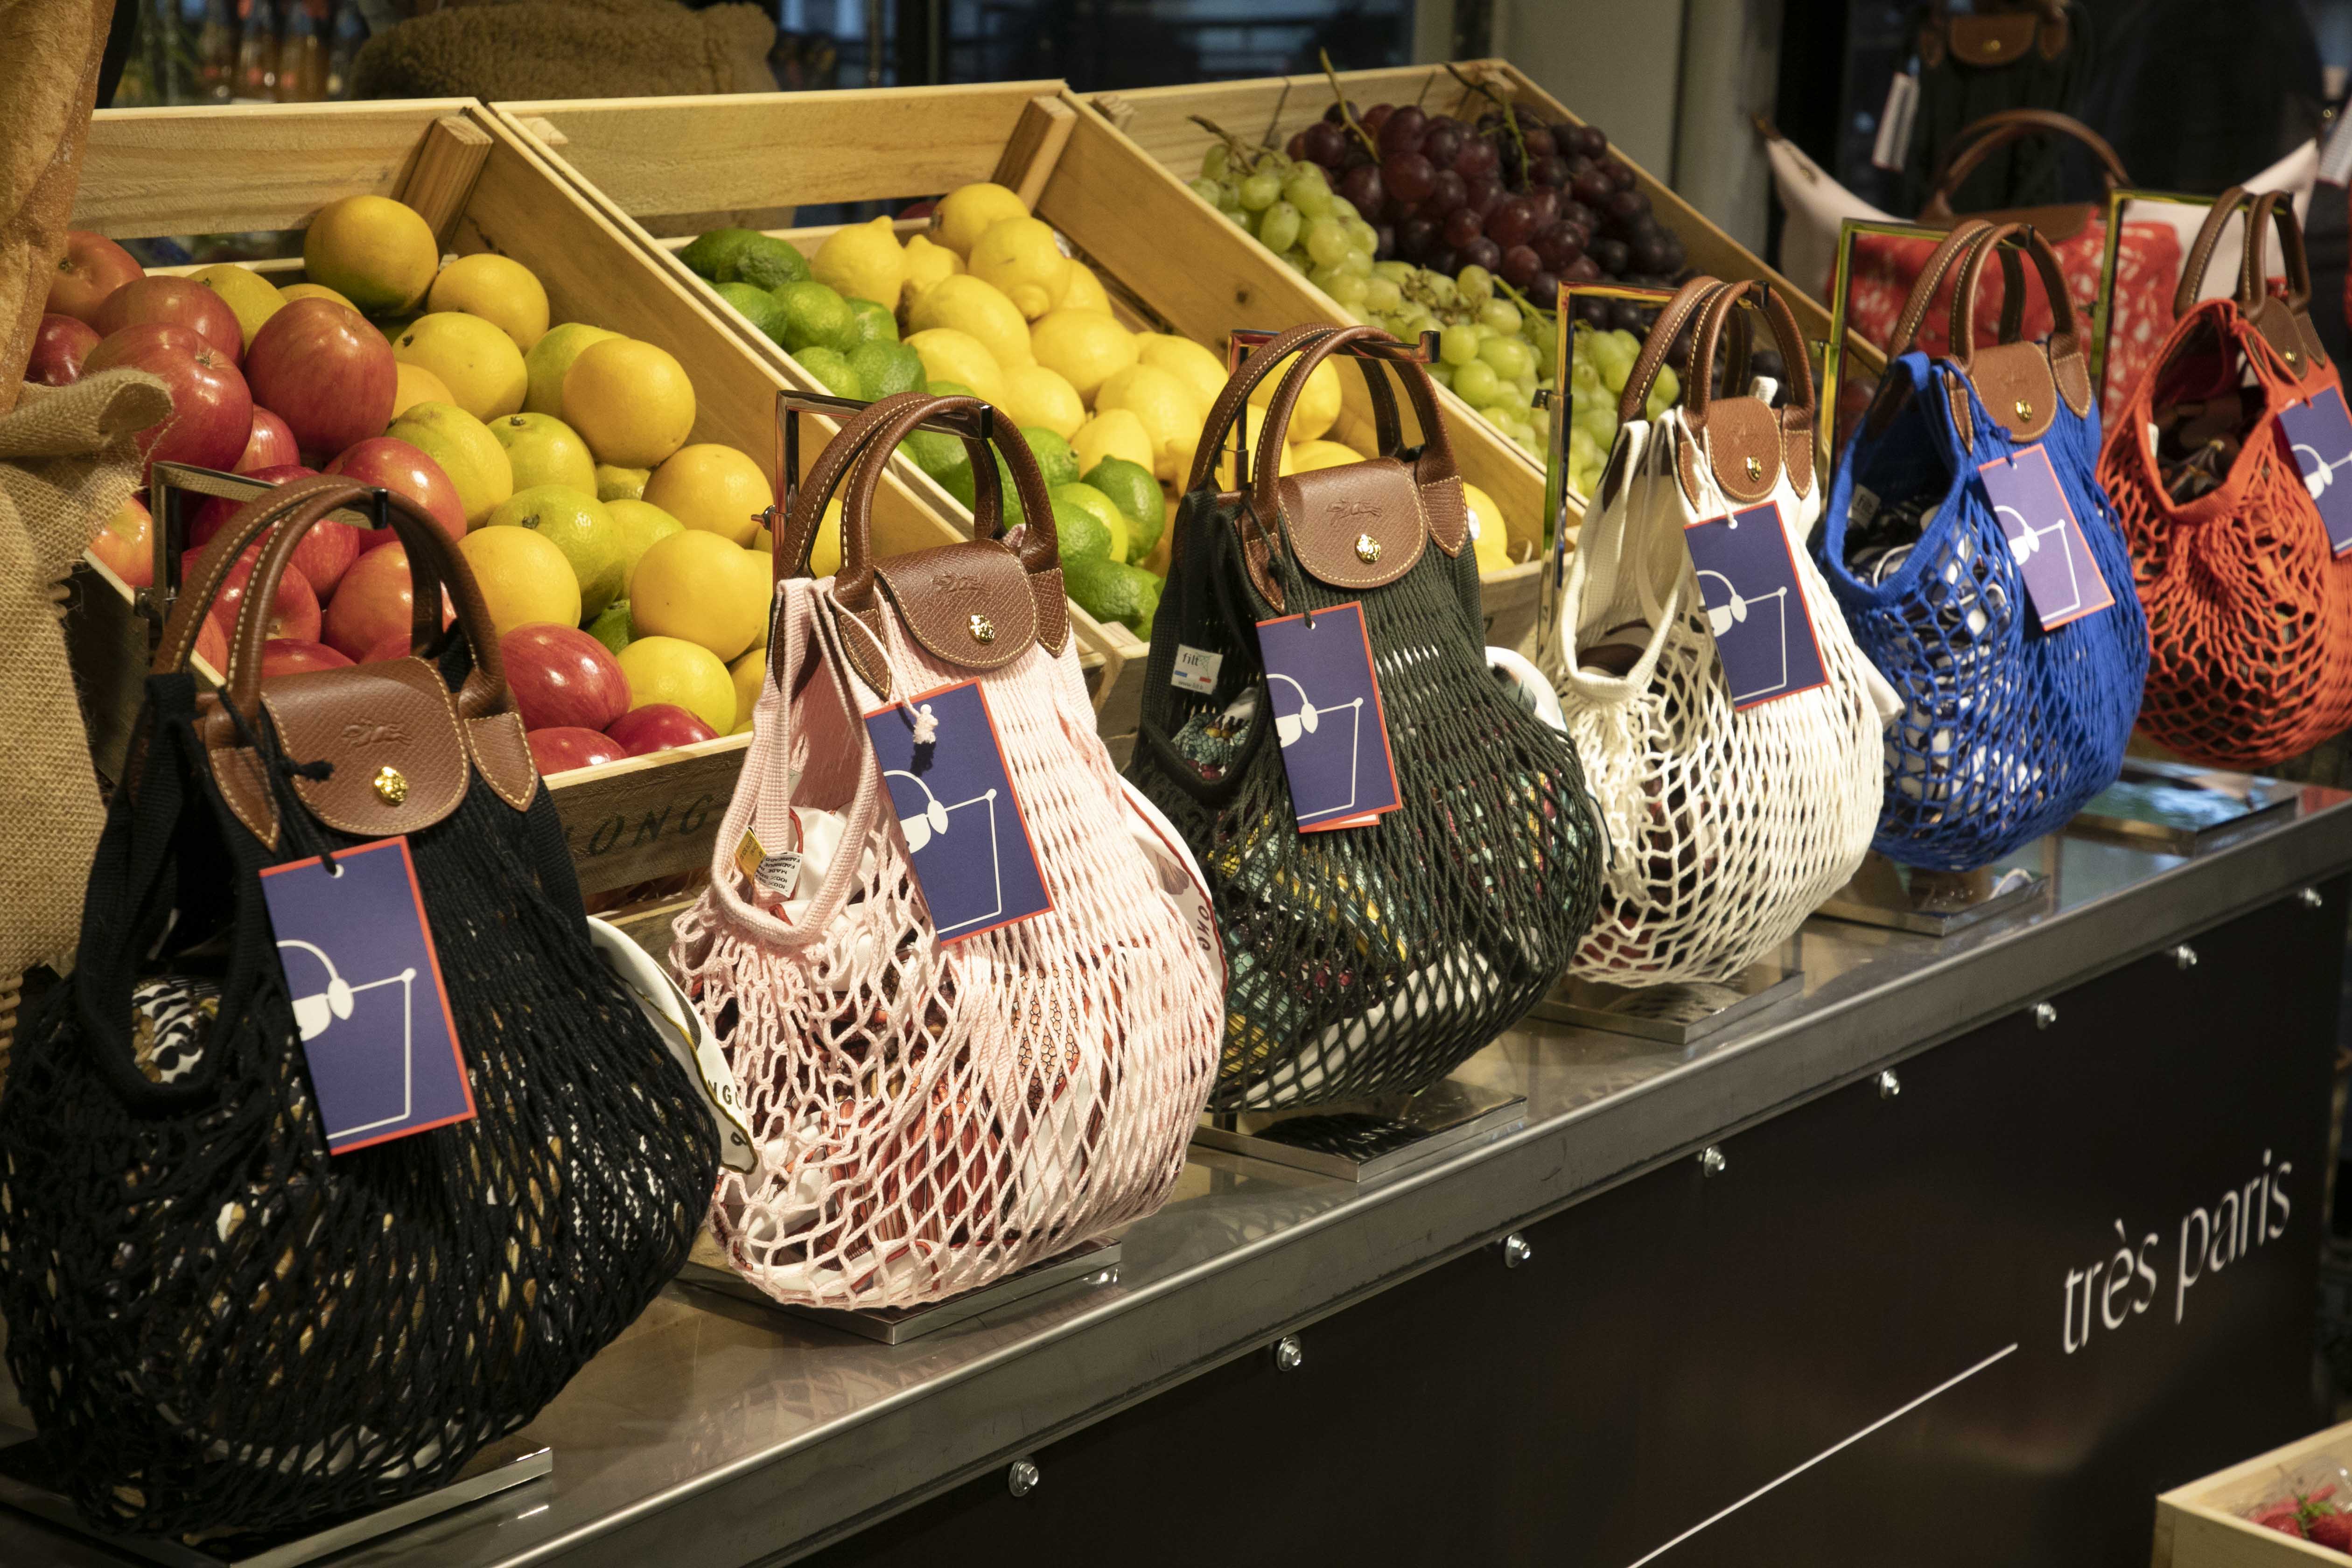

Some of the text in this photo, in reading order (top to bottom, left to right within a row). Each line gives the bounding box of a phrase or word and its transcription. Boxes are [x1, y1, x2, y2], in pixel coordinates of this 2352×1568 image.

[1182, 653, 1199, 666] filt
[563, 794, 715, 857] ONG
[2063, 1148, 2292, 1354] très paris
